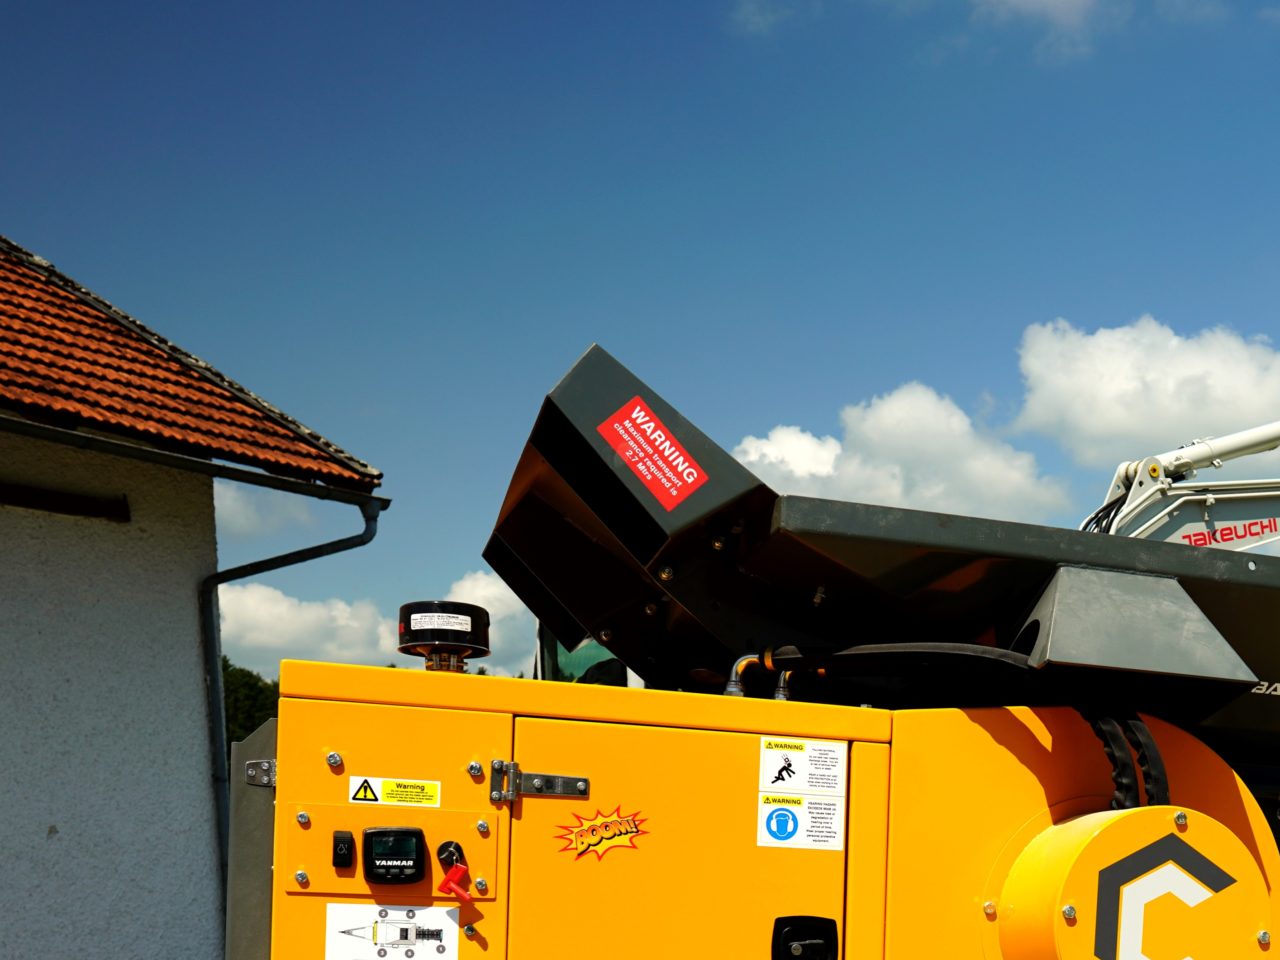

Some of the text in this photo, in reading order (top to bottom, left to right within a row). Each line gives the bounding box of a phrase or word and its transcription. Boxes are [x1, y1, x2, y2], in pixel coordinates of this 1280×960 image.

[613, 423, 678, 496] clearance required is
[623, 419, 683, 487] Maximum transport
[625, 449, 639, 462] 2.7
[631, 405, 698, 484] WARNING
[774, 743, 804, 751] WARNING
[396, 783, 425, 791] Warning
[575, 819, 639, 856] BOOM!
